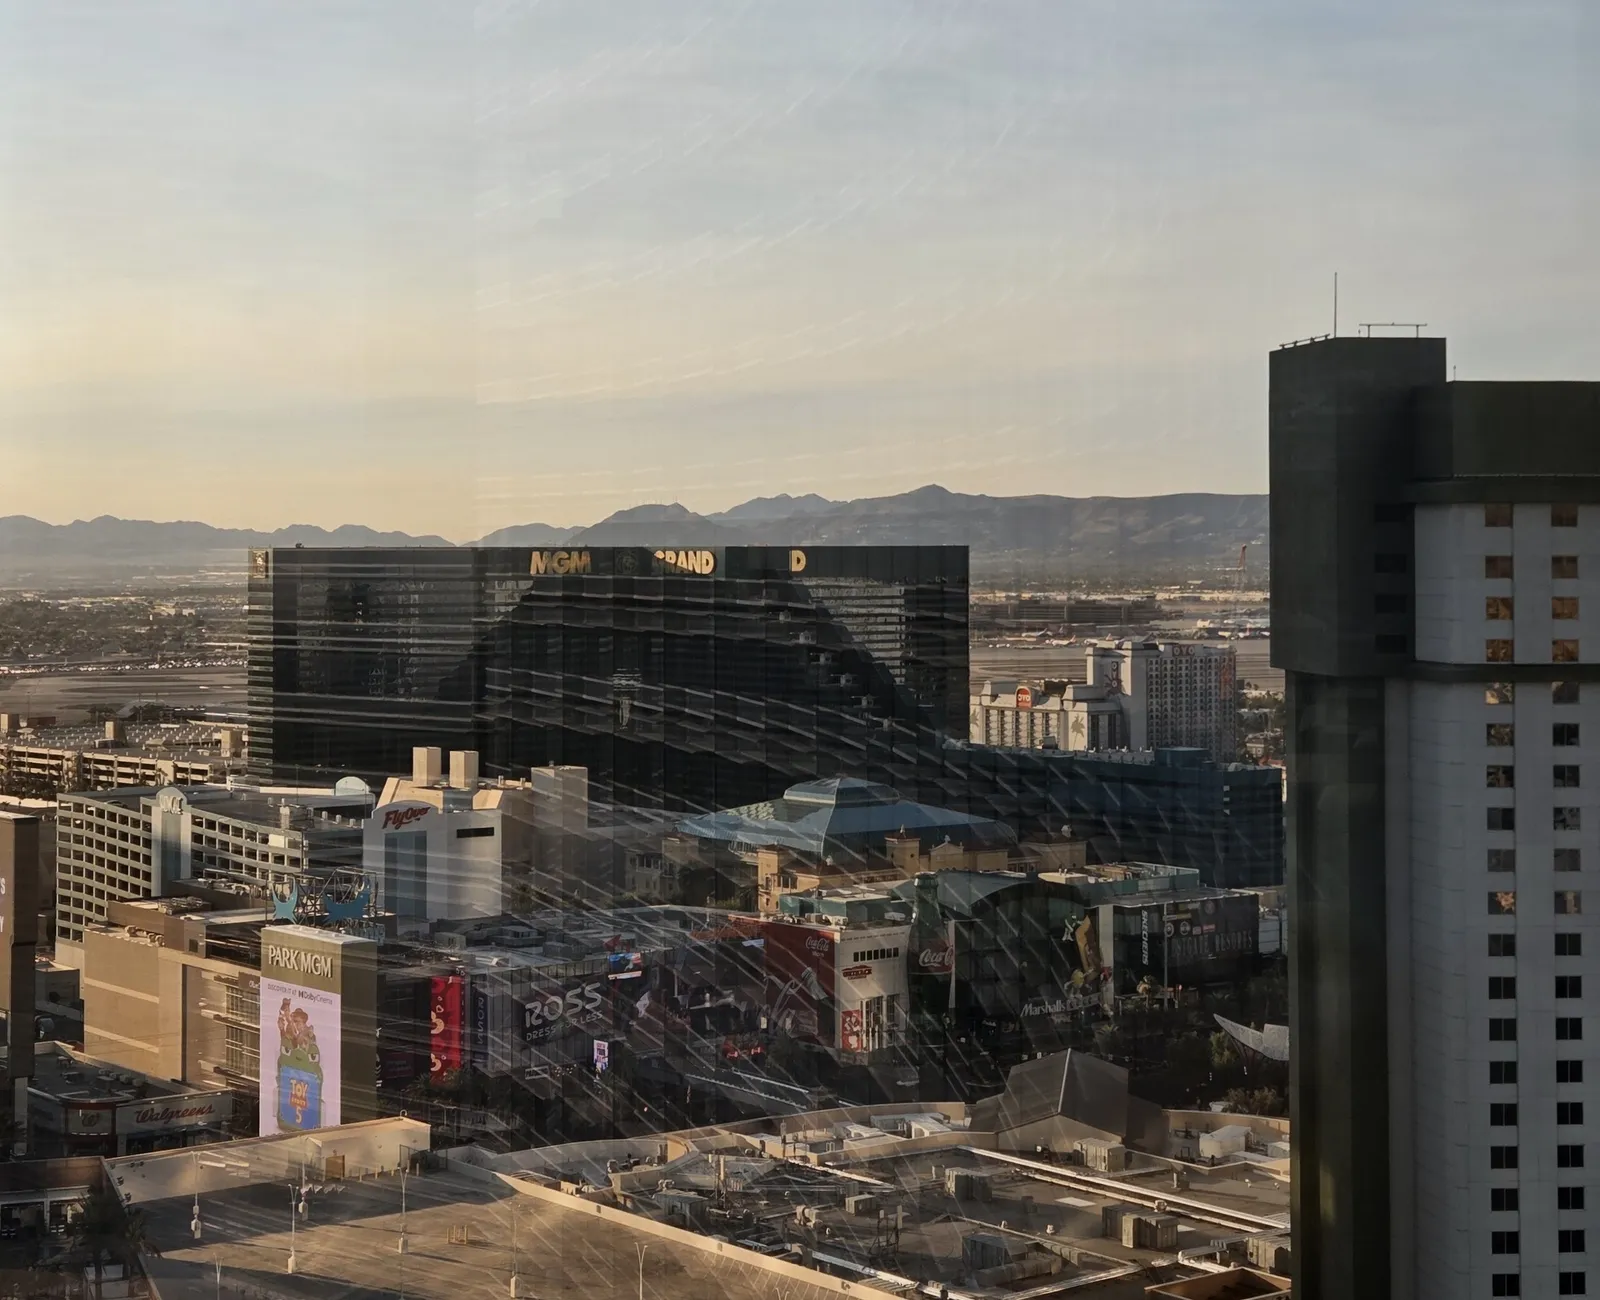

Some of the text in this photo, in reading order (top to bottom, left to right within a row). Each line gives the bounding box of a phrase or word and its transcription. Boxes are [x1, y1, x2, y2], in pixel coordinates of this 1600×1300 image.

[529, 549, 717, 576] MGM GRAND
[1173, 645, 1195, 656] OYO
[1017, 693, 1031, 702] OYO
[268, 944, 333, 979] PARK MGM
[525, 981, 602, 1029] ROSS
[1019, 999, 1066, 1018] Marshalls
[477, 997, 485, 1045] ROSS
[525, 1010, 603, 1042] DRESS FOR LESS
[290, 1078, 308, 1099] TOY
[134, 1103, 216, 1125] Walgreens
[295, 1106, 302, 1124] 5
